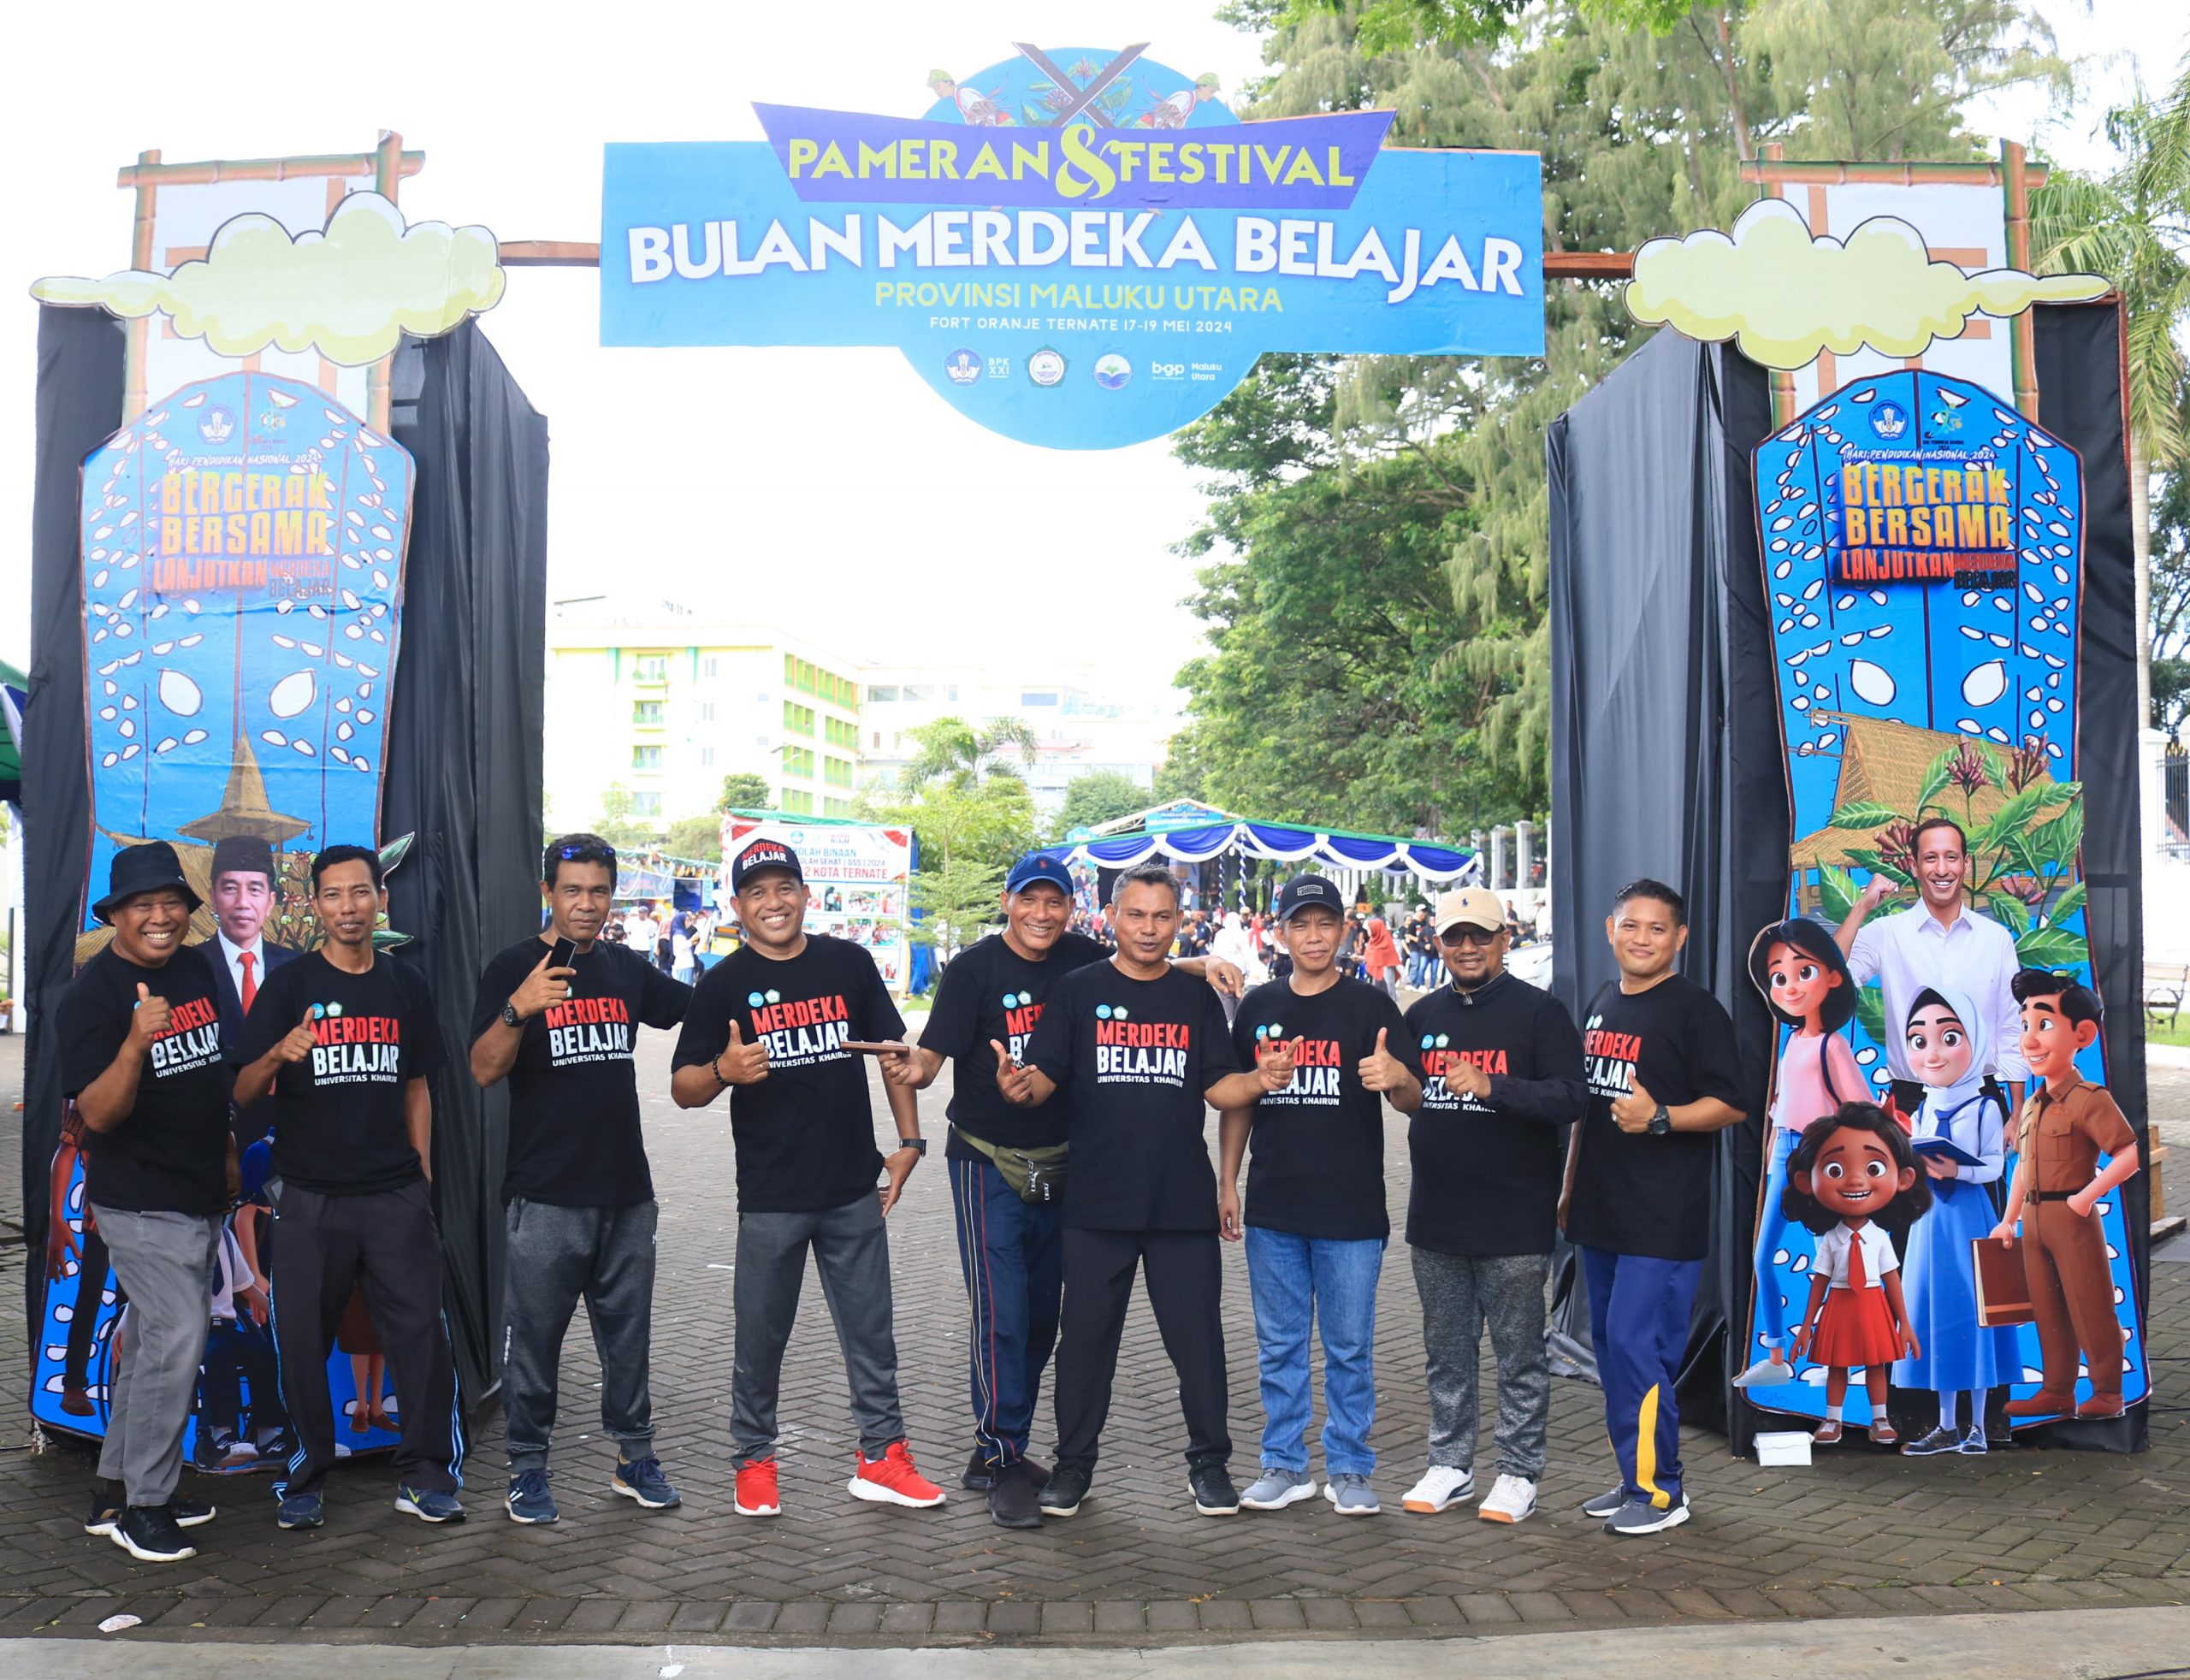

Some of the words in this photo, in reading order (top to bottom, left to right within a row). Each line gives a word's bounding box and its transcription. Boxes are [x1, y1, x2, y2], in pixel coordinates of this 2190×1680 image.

[788, 139, 1049, 180] PAMERAN
[1055, 122, 1122, 200] &
[1119, 141, 1355, 187] FESTIVAL
[628, 212, 862, 284] BULAN
[878, 210, 1218, 270] MERDEKA
[1235, 216, 1525, 305] BELAJAR
[875, 281, 1021, 308] PROVINSI
[1030, 282, 1164, 310] MALUKU
[1176, 285, 1283, 312] UTARA
[930, 316, 971, 329] FORT
[977, 317, 1040, 330] ORANJE
[1046, 318, 1118, 331] TERNATE
[1123, 319, 1157, 331] 17-19
[1163, 320, 1190, 332] MEI
[1196, 321, 1233, 333] 2024
[988, 358, 1009, 366] BPK
[989, 365, 1009, 375] XXI
[1192, 362, 1222, 371] Maluku
[1192, 372, 1216, 381] Utara
[169, 456, 189, 467] HARI
[192, 453, 246, 467] PENDIDIKAN
[247, 453, 290, 465] NASIONAL
[294, 453, 319, 464] 2024
[1846, 449, 1867, 460] HARI
[1871, 448, 1923, 461] PENDIDIKAN
[1925, 448, 1968, 461] NASIONAL
[1971, 449, 1995, 460] 2024
[163, 471, 328, 515] BERGERAK
[1844, 464, 2008, 506] BERGERAK
[161, 510, 328, 556] BERSAMA
[1844, 505, 2010, 548] BERSAMA
[153, 559, 267, 590] LANJUTKAN
[269, 559, 331, 578] MERDEKA
[1840, 548, 1955, 580] LANJUTKAN
[742, 842, 785, 861] MERDEKA
[742, 851, 788, 871] BELAJAR
[793, 848, 821, 856] KOLAH
[824, 849, 856, 857] BINAAN
[804, 867, 811, 877] 2
[814, 867, 839, 878] KOTA
[843, 868, 888, 879] TERNATE
[153, 997, 218, 1040] RDEKA
[545, 997, 630, 1029] MERDEKA
[750, 995, 849, 1035] MERDEKA
[309, 1016, 400, 1046] MERDEKA
[549, 1023, 630, 1057] BELAJAR
[758, 1020, 849, 1059] BELAJAR
[1096, 1020, 1190, 1050] MERDEKA
[156, 1058, 206, 1078] UNIVERSITAS
[311, 1044, 400, 1076] BELAJAR
[552, 1053, 606, 1067] UNIVERSITAS
[768, 1056, 816, 1069] NIVERSITAS
[1096, 1045, 1187, 1079] BELAJAR
[1584, 1056, 1637, 1091] LAJAR
[314, 1074, 368, 1086] UNIVERSITAS
[1098, 1074, 1150, 1084] UNIVERSITAS
[1268, 1067, 1341, 1096] AJAR
[1302, 1097, 1340, 1106] KHAIRUN
